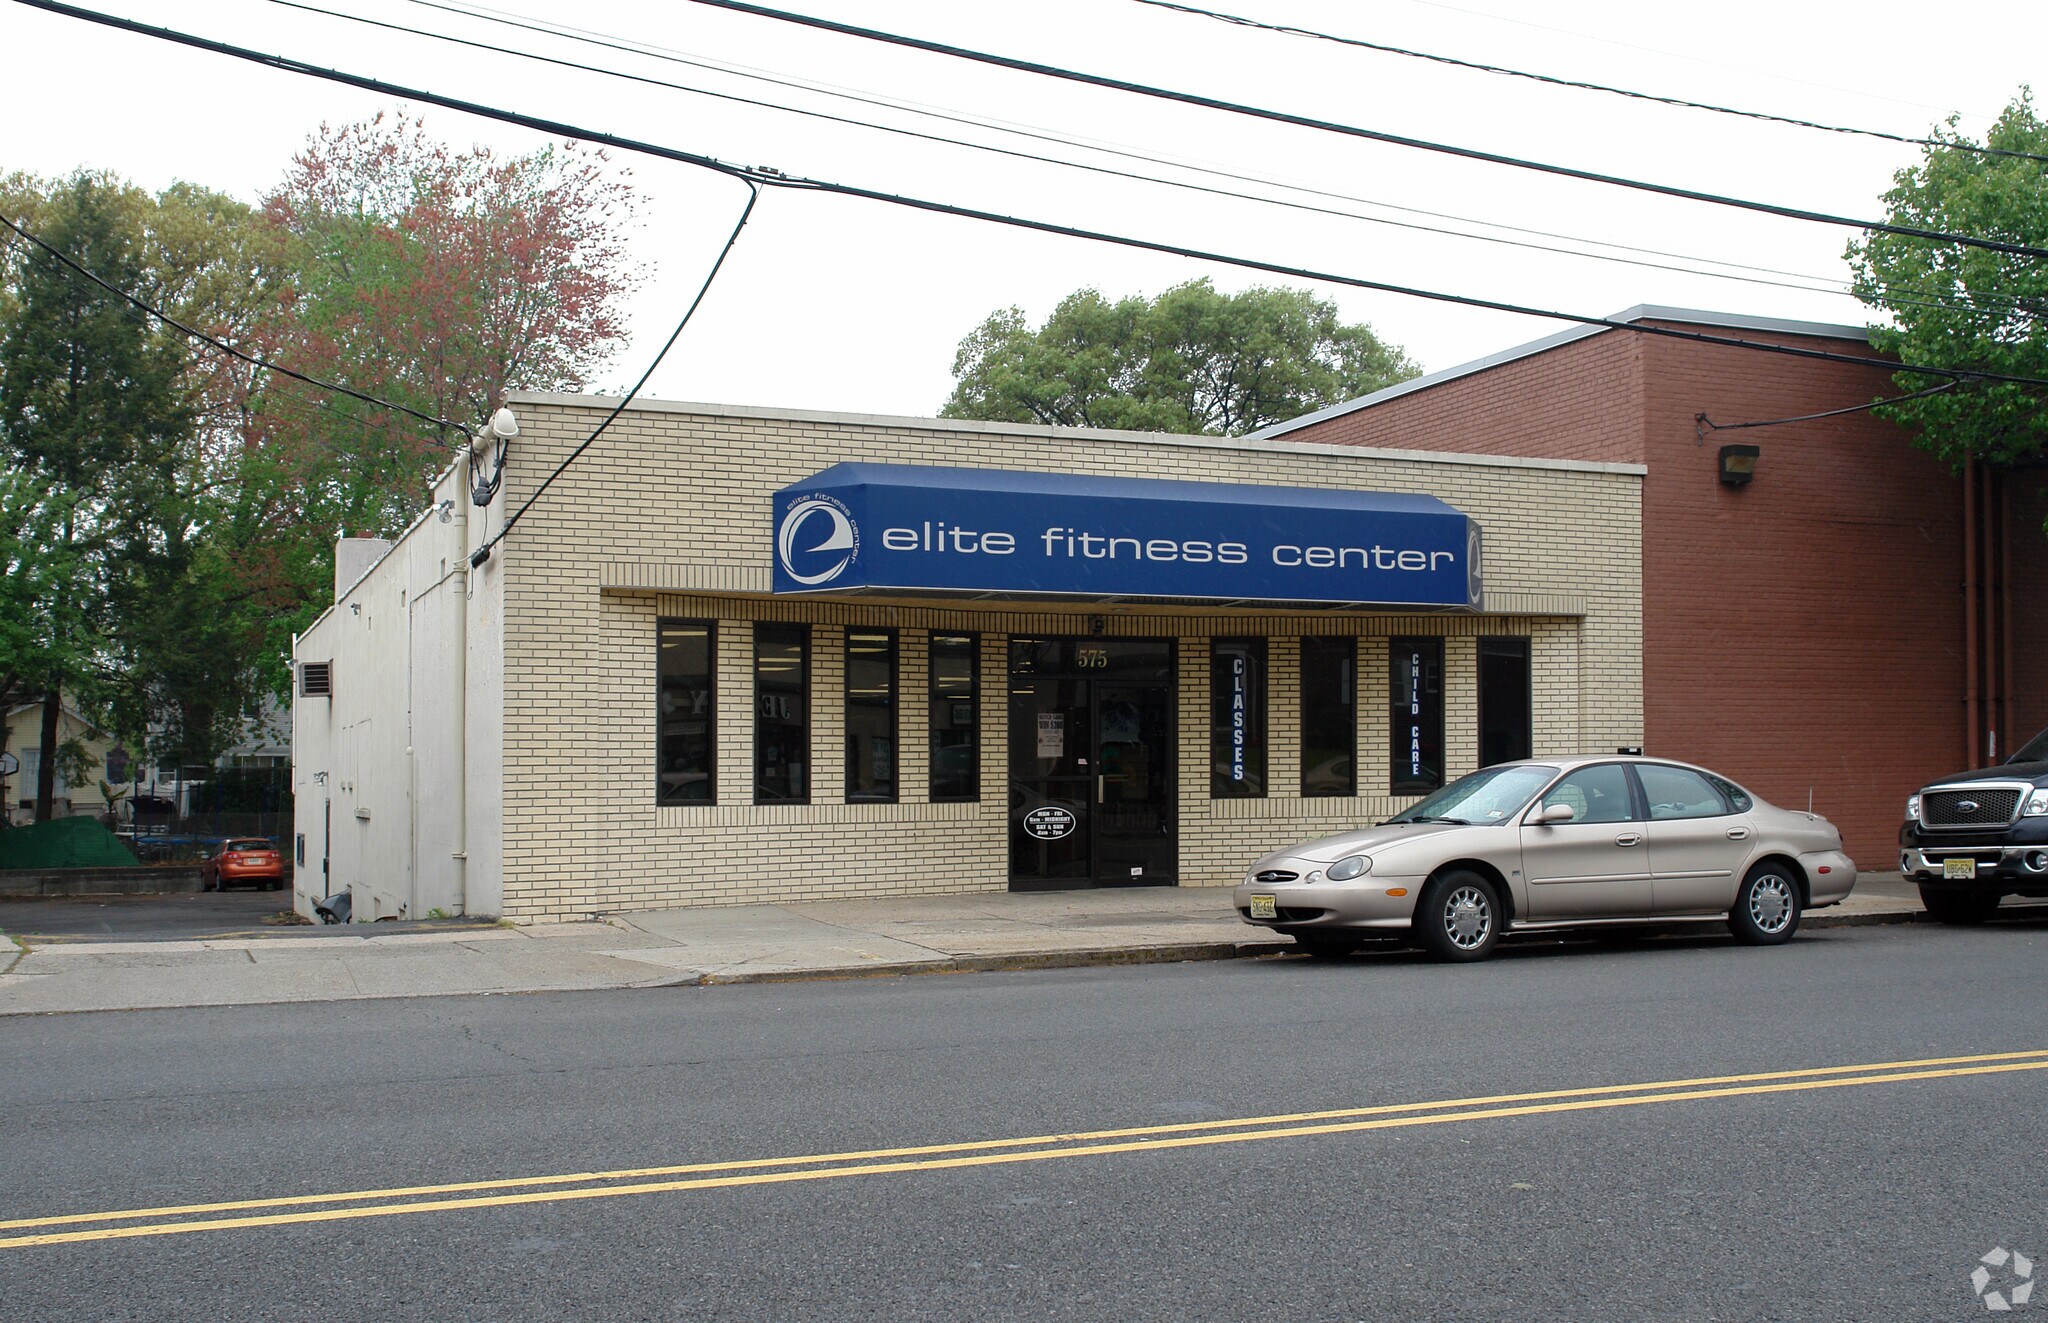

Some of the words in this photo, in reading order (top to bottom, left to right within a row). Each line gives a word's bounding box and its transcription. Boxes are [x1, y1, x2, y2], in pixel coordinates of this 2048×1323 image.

[787, 494, 811, 510] elite
[814, 492, 851, 517] fitness
[850, 519, 860, 564] center
[882, 521, 1016, 555] elite
[1040, 527, 1248, 564] fitness
[1272, 544, 1455, 572] center
[1078, 649, 1108, 668] 575
[1411, 653, 1420, 715] CHILD
[1233, 658, 1244, 781] CLASSES
[1411, 726, 1420, 775] CARE
